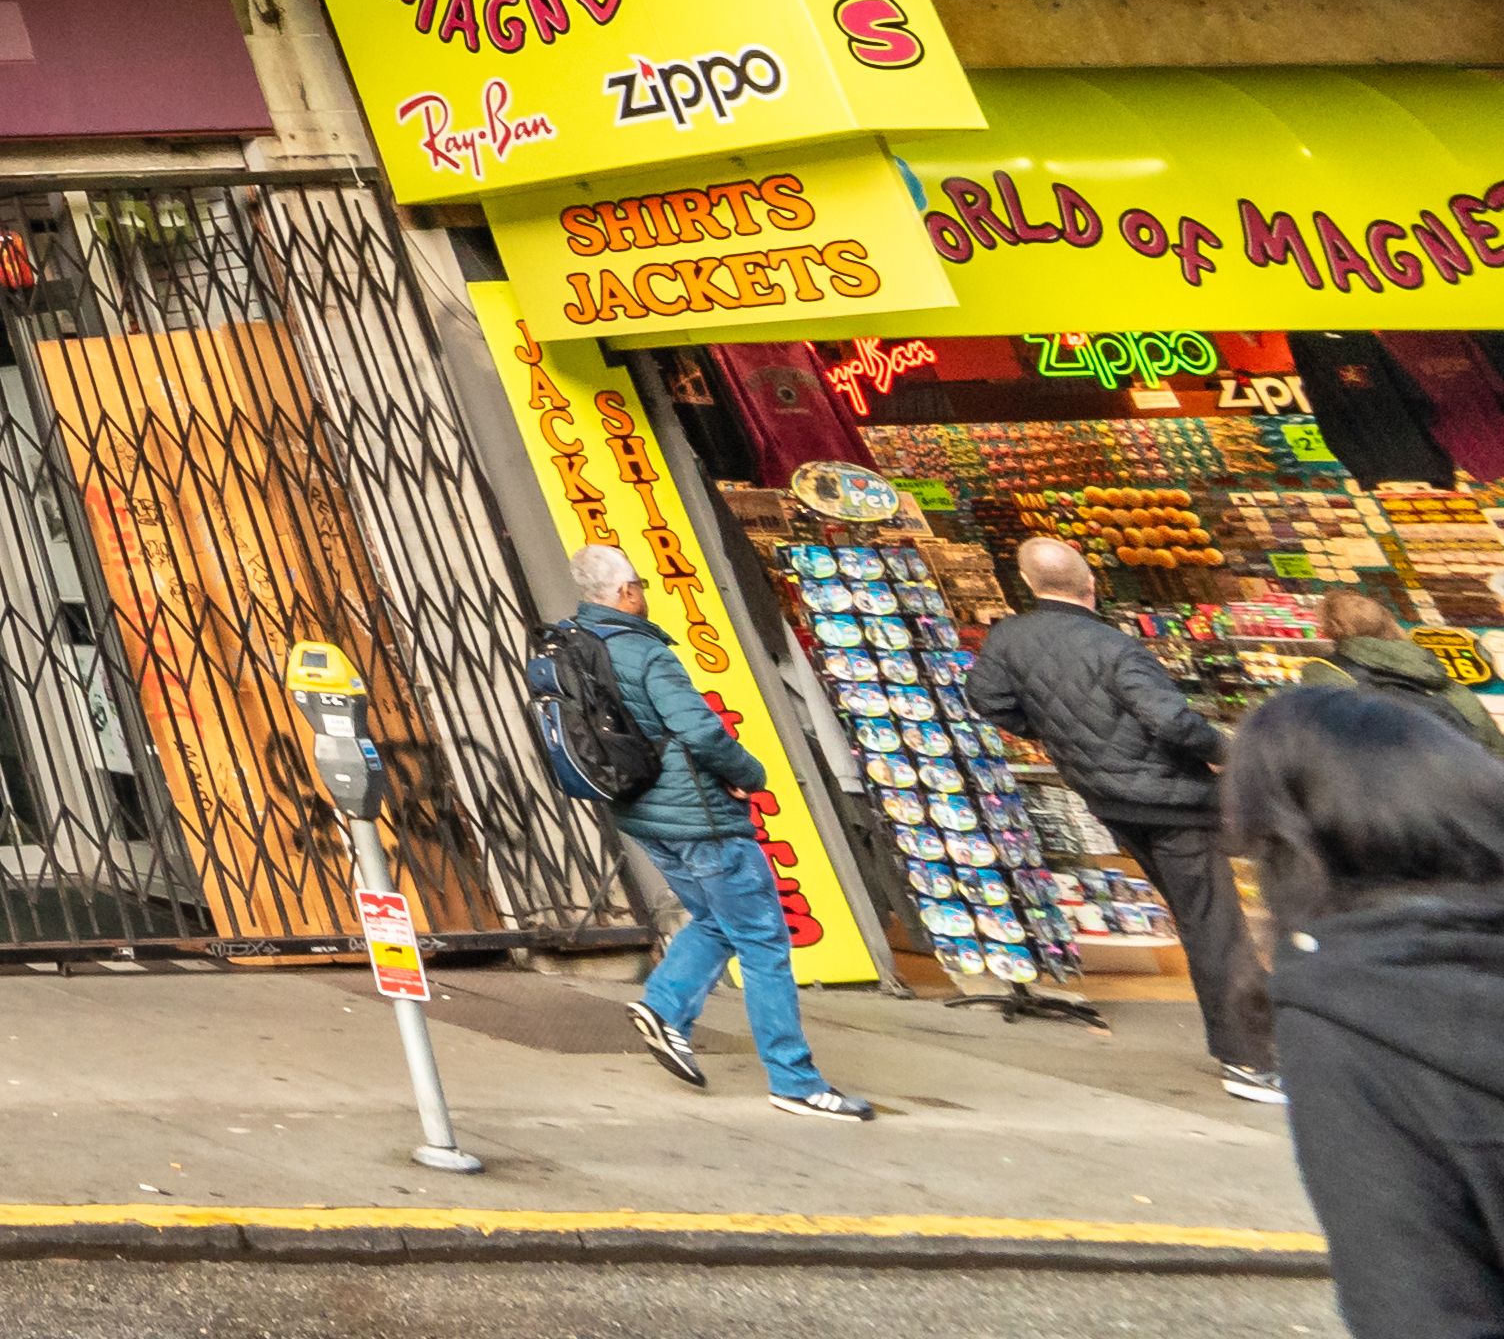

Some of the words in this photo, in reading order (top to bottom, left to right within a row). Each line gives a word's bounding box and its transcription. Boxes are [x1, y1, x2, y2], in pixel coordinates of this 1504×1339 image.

[560, 175, 816, 257] SHIRTS
[923, 170, 1103, 265] ORLD
[563, 240, 881, 325] JACKETS
[595, 389, 730, 674] SHIRTS
[849, 490, 892, 510] Pet
